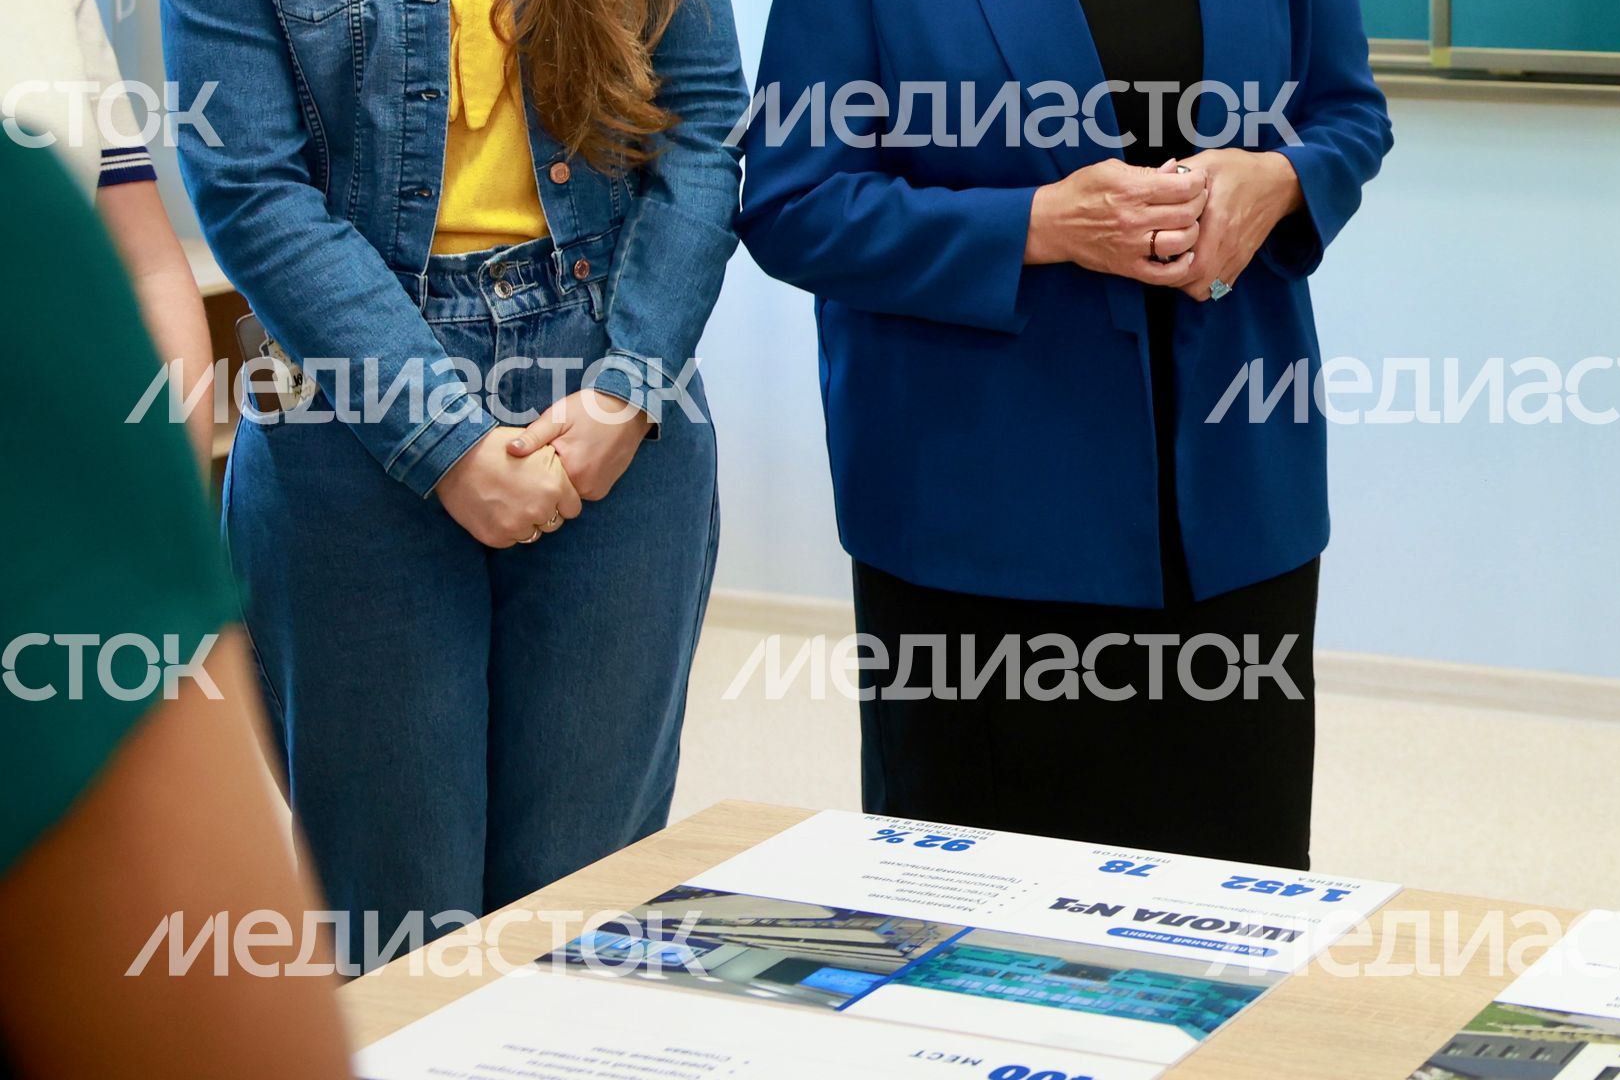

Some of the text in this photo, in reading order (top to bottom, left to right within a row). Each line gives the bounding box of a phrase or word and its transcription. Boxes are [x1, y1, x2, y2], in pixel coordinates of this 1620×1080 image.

[868, 829, 976, 852] 92 %
[1092, 850, 1172, 864] ПЕДАГОГОВ
[1098, 860, 1159, 877] 78
[902, 872, 1009, 891] Технологические
[1220, 875, 1315, 897] 452
[867, 892, 976, 913] Математические
[895, 888, 988, 905] Гуманитарные
[1048, 897, 1304, 943] ШКОЛА №1
[1120, 929, 1170, 942] РЕМОНТ
[909, 1049, 984, 1066] МЕСТ
